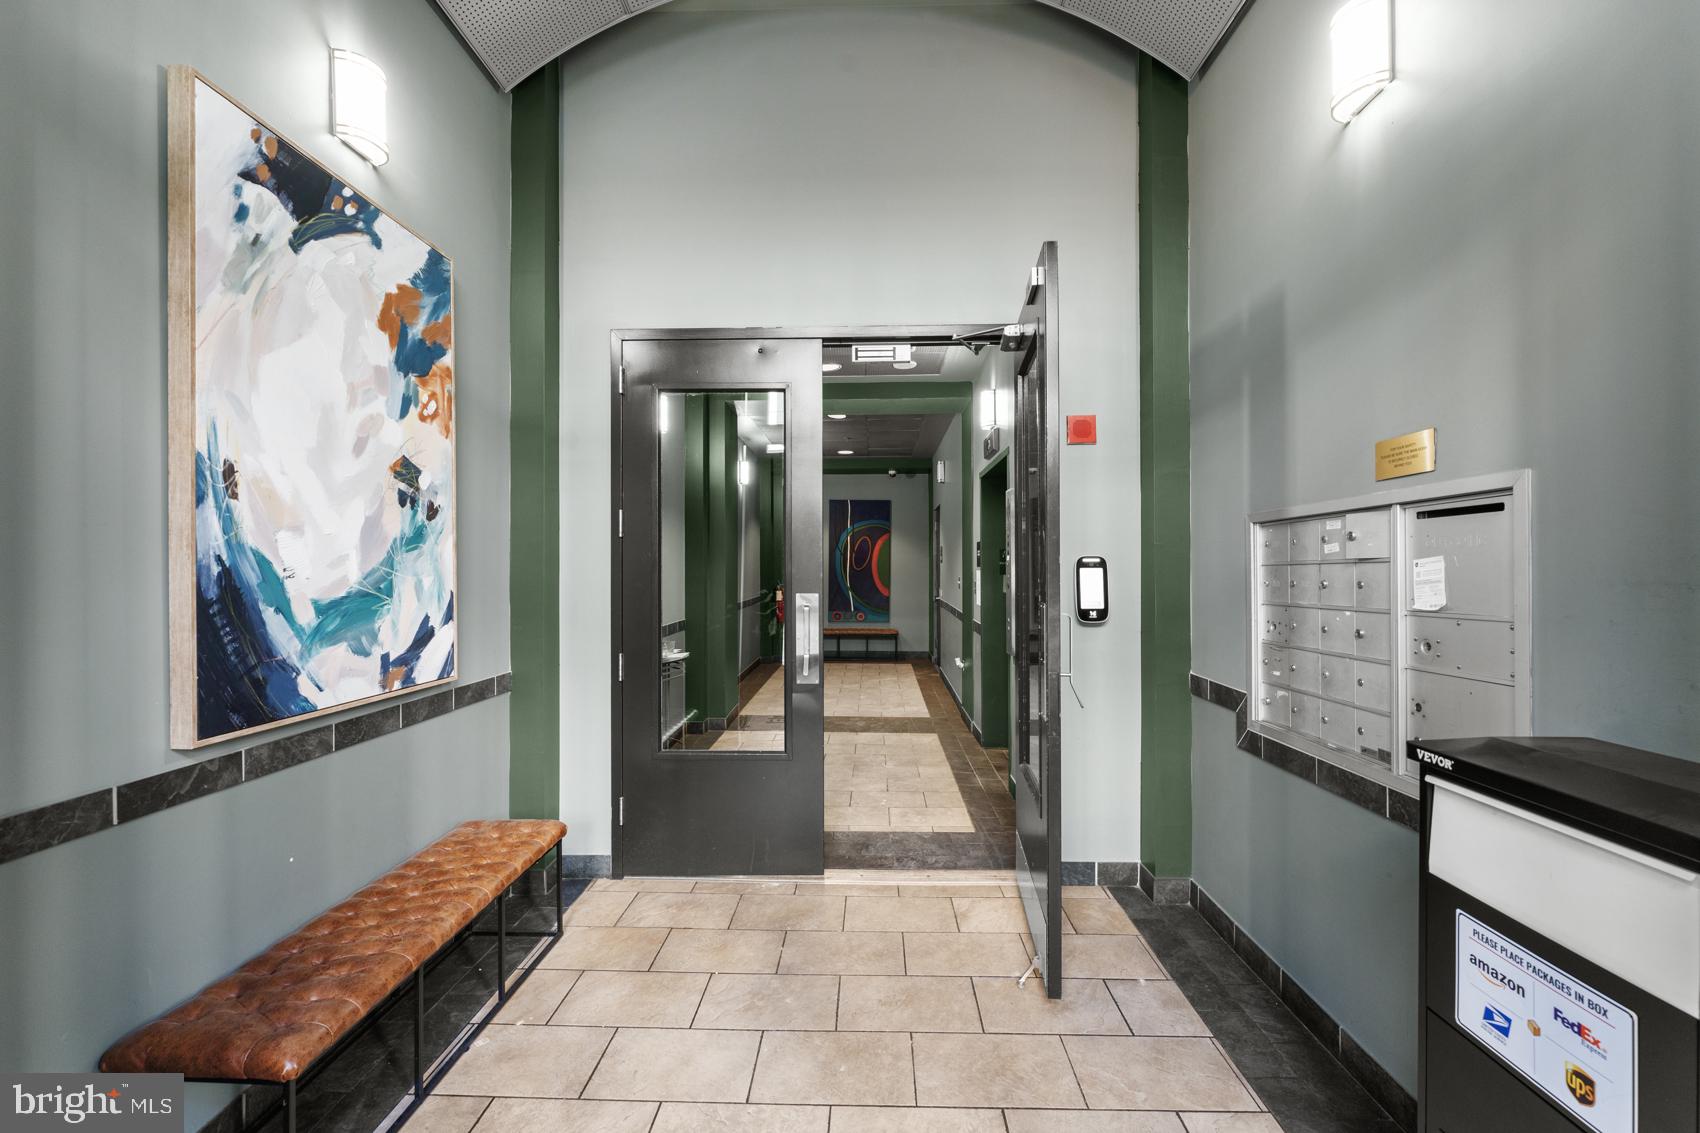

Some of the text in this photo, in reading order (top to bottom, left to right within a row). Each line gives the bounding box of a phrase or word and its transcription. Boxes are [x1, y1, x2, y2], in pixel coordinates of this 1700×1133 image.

[1416, 748, 1453, 770] VEVOR
[1469, 953, 1526, 998] amazon
[1472, 928, 1609, 1019] PLEASE PLACE PACKAGES IN BOX
[1553, 1006, 1601, 1049] FedEx
[1567, 1070, 1594, 1101] ups
